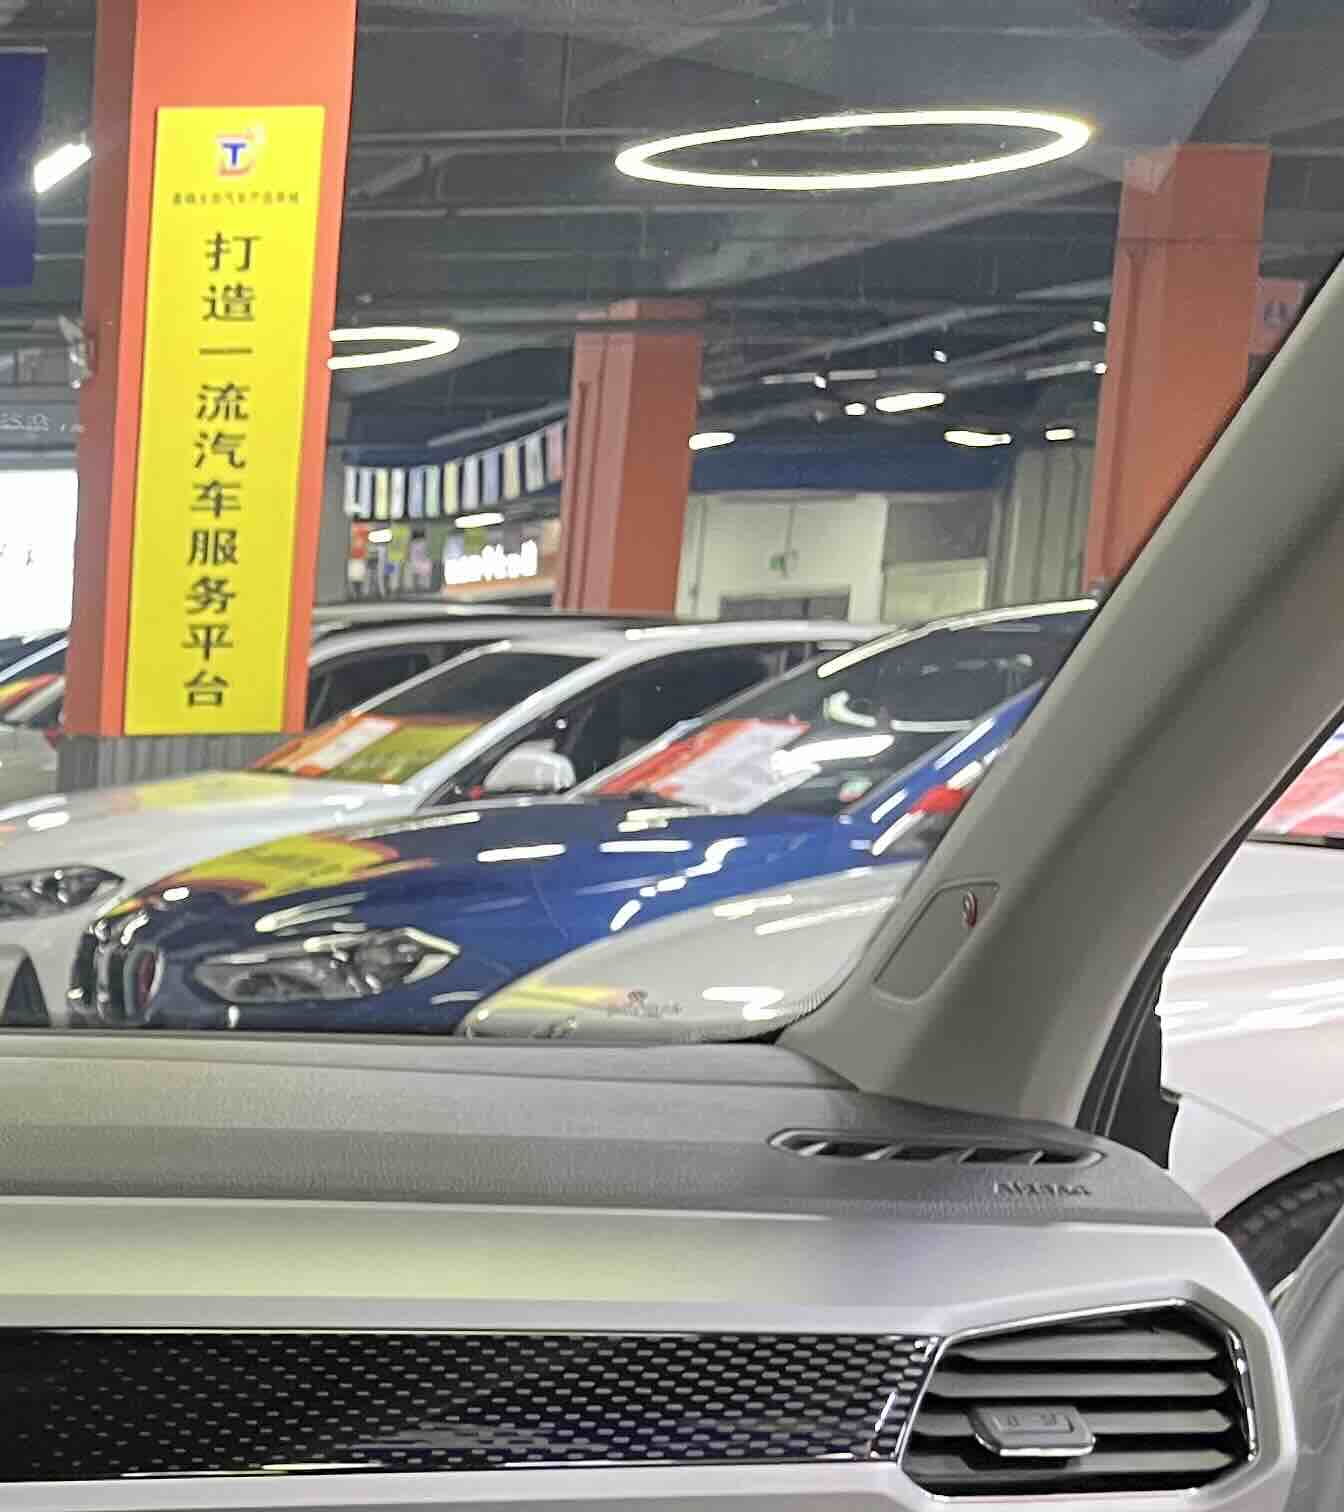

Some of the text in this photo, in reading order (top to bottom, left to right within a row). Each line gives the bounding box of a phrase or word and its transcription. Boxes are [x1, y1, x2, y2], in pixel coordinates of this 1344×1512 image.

[181, 230, 262, 708] 打造一流汽车服务平台
